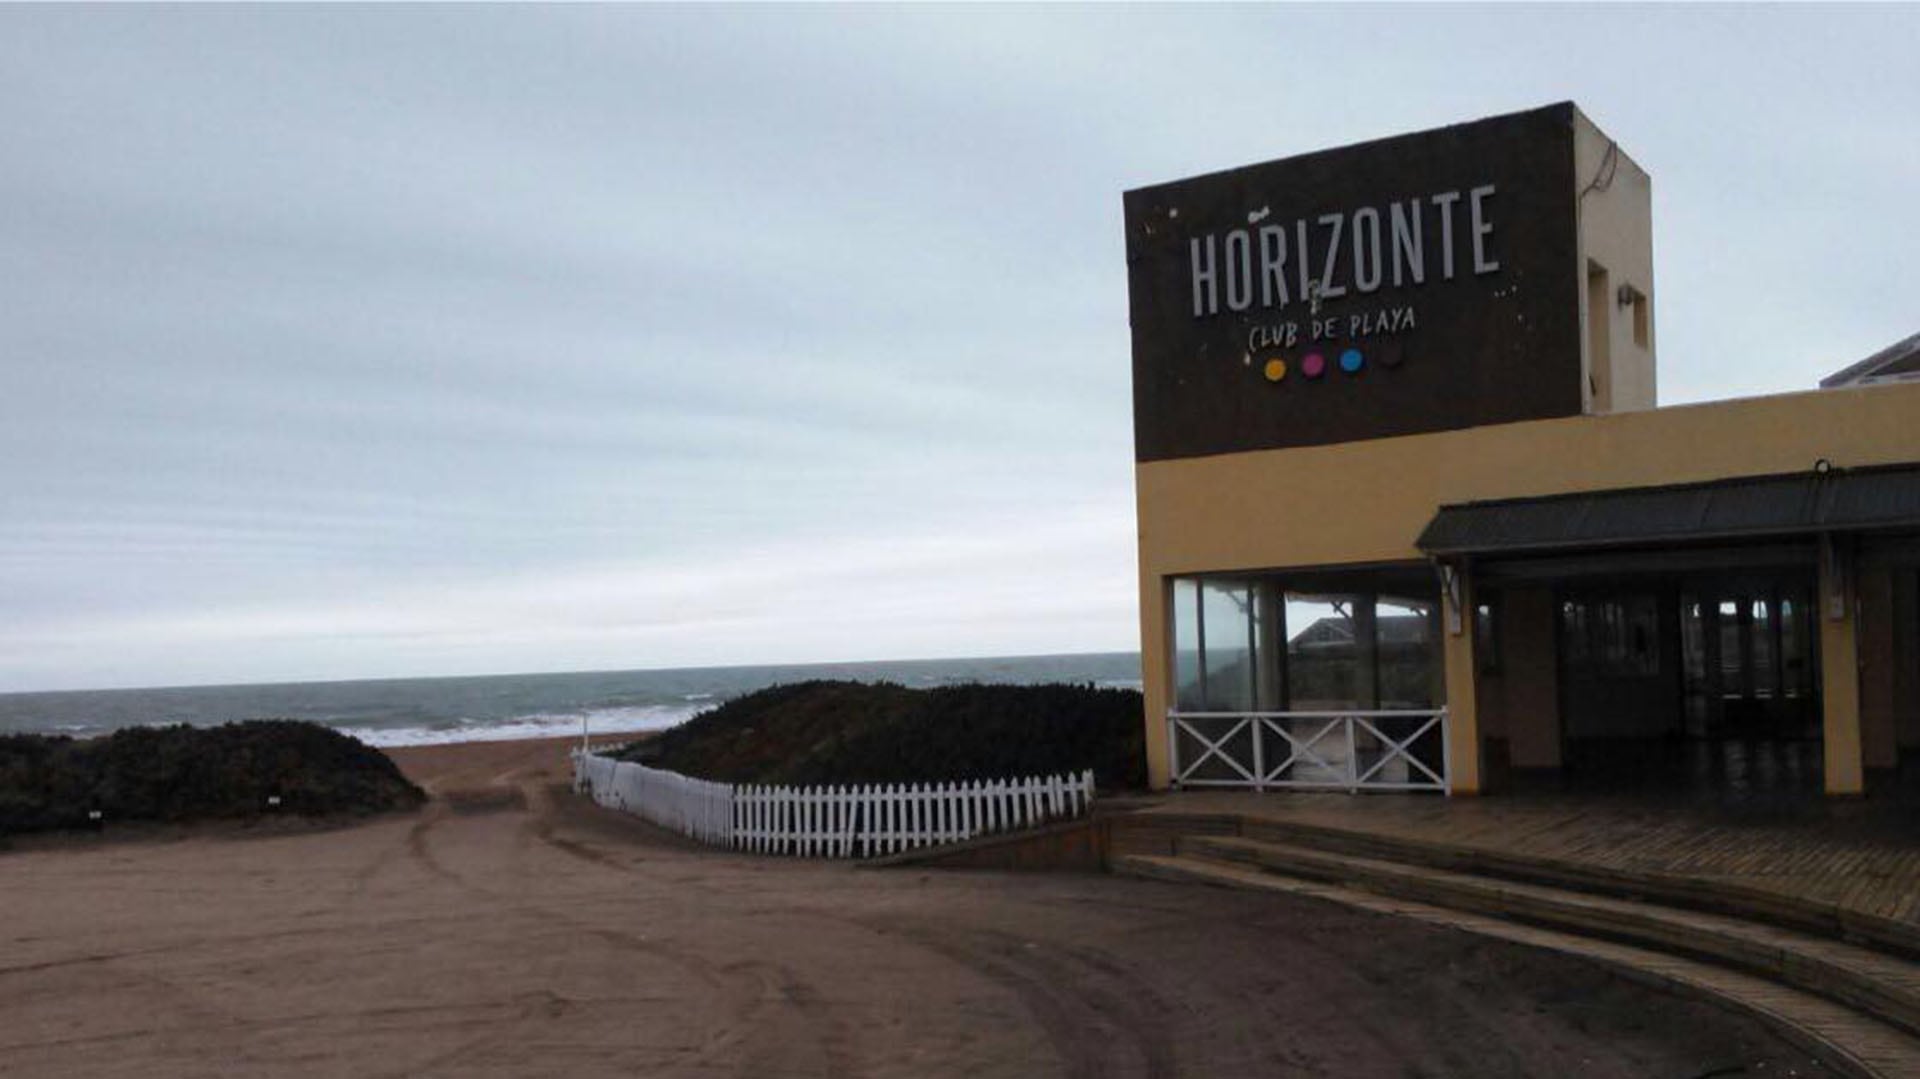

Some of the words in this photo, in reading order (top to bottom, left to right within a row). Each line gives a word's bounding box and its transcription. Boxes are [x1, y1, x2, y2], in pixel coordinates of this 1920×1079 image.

[1190, 185, 1499, 317] HORIZONTE
[1249, 322, 1298, 352] CLUB
[1311, 316, 1340, 340] DE
[1349, 305, 1416, 337] PLAYA
